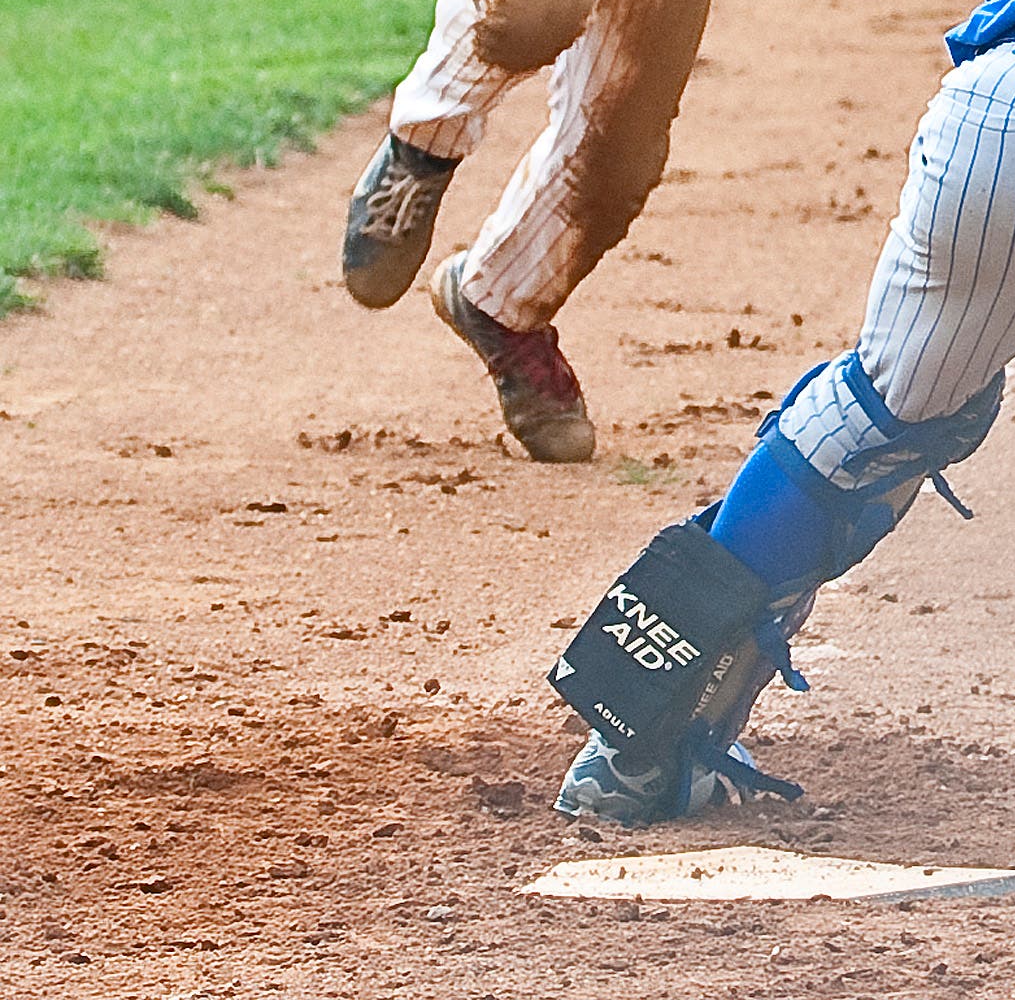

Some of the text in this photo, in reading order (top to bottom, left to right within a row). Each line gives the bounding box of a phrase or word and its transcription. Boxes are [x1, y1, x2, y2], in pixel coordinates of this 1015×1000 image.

[606, 583, 701, 667] KNEE
[713, 652, 735, 681] AID
[593, 702, 637, 739] ADULT
